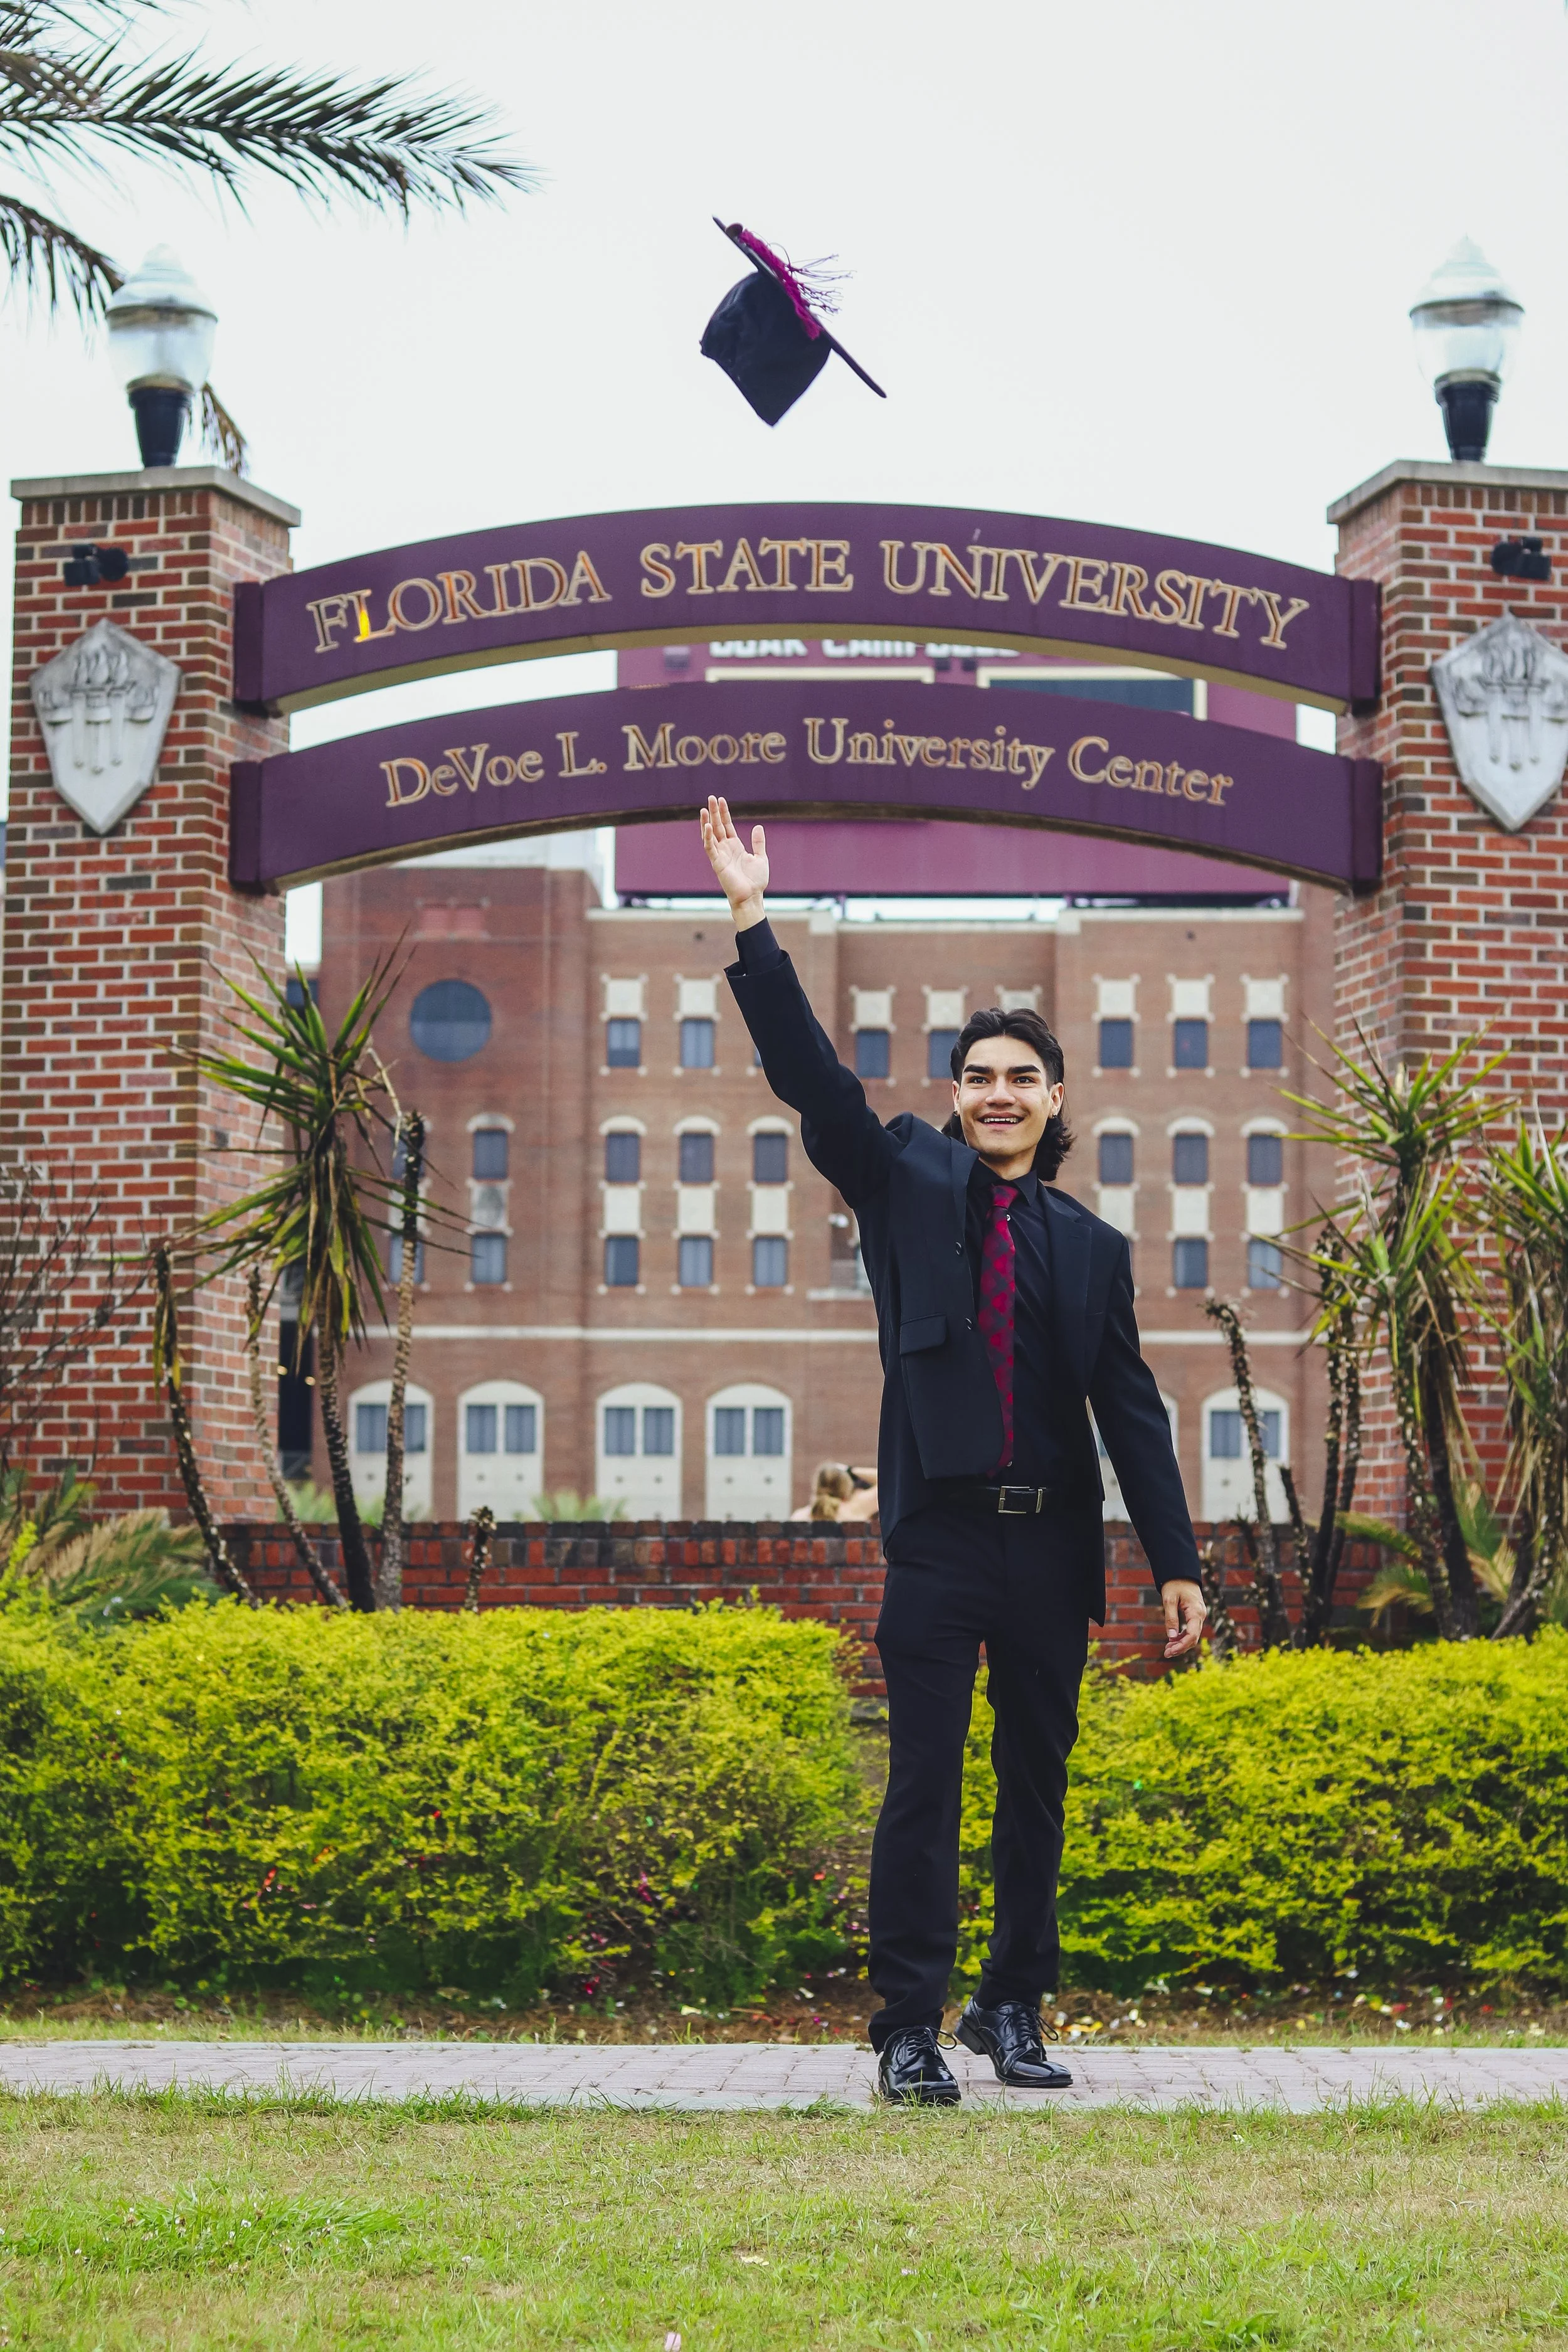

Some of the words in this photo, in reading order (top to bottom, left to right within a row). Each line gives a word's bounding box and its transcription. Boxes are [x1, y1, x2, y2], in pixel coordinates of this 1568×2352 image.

[306, 550, 612, 653] FLORIDA
[640, 538, 854, 598] STATE
[879, 540, 1310, 650] UNIVERSITY
[379, 743, 545, 808] DeVoe
[556, 731, 608, 778] L.
[622, 723, 787, 771] Moore
[803, 717, 1056, 790] University
[1067, 736, 1234, 807] Center
